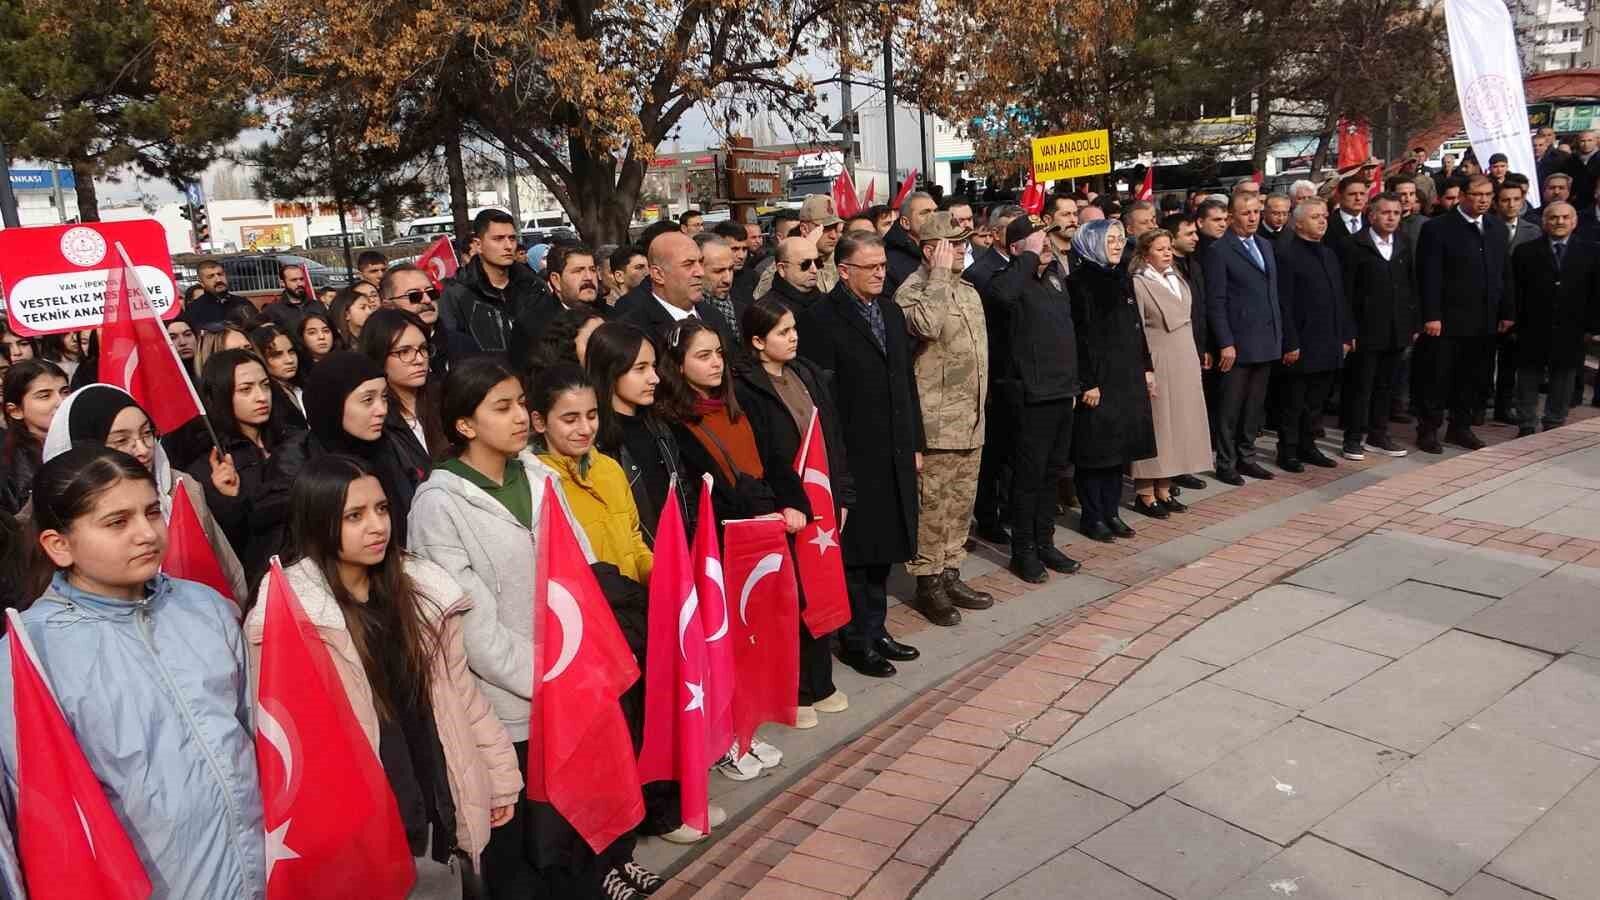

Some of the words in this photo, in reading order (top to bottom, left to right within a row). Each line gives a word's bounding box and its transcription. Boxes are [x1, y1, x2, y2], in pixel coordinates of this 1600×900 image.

[1041, 143, 1057, 156] VAN
[1059, 138, 1100, 154] ANADOLU
[59, 283, 77, 291] VAN
[19, 296, 68, 309] VESTEL
[71, 292, 91, 304] KIZ
[147, 285, 162, 295] VE
[23, 309, 71, 324] TEKNİK
